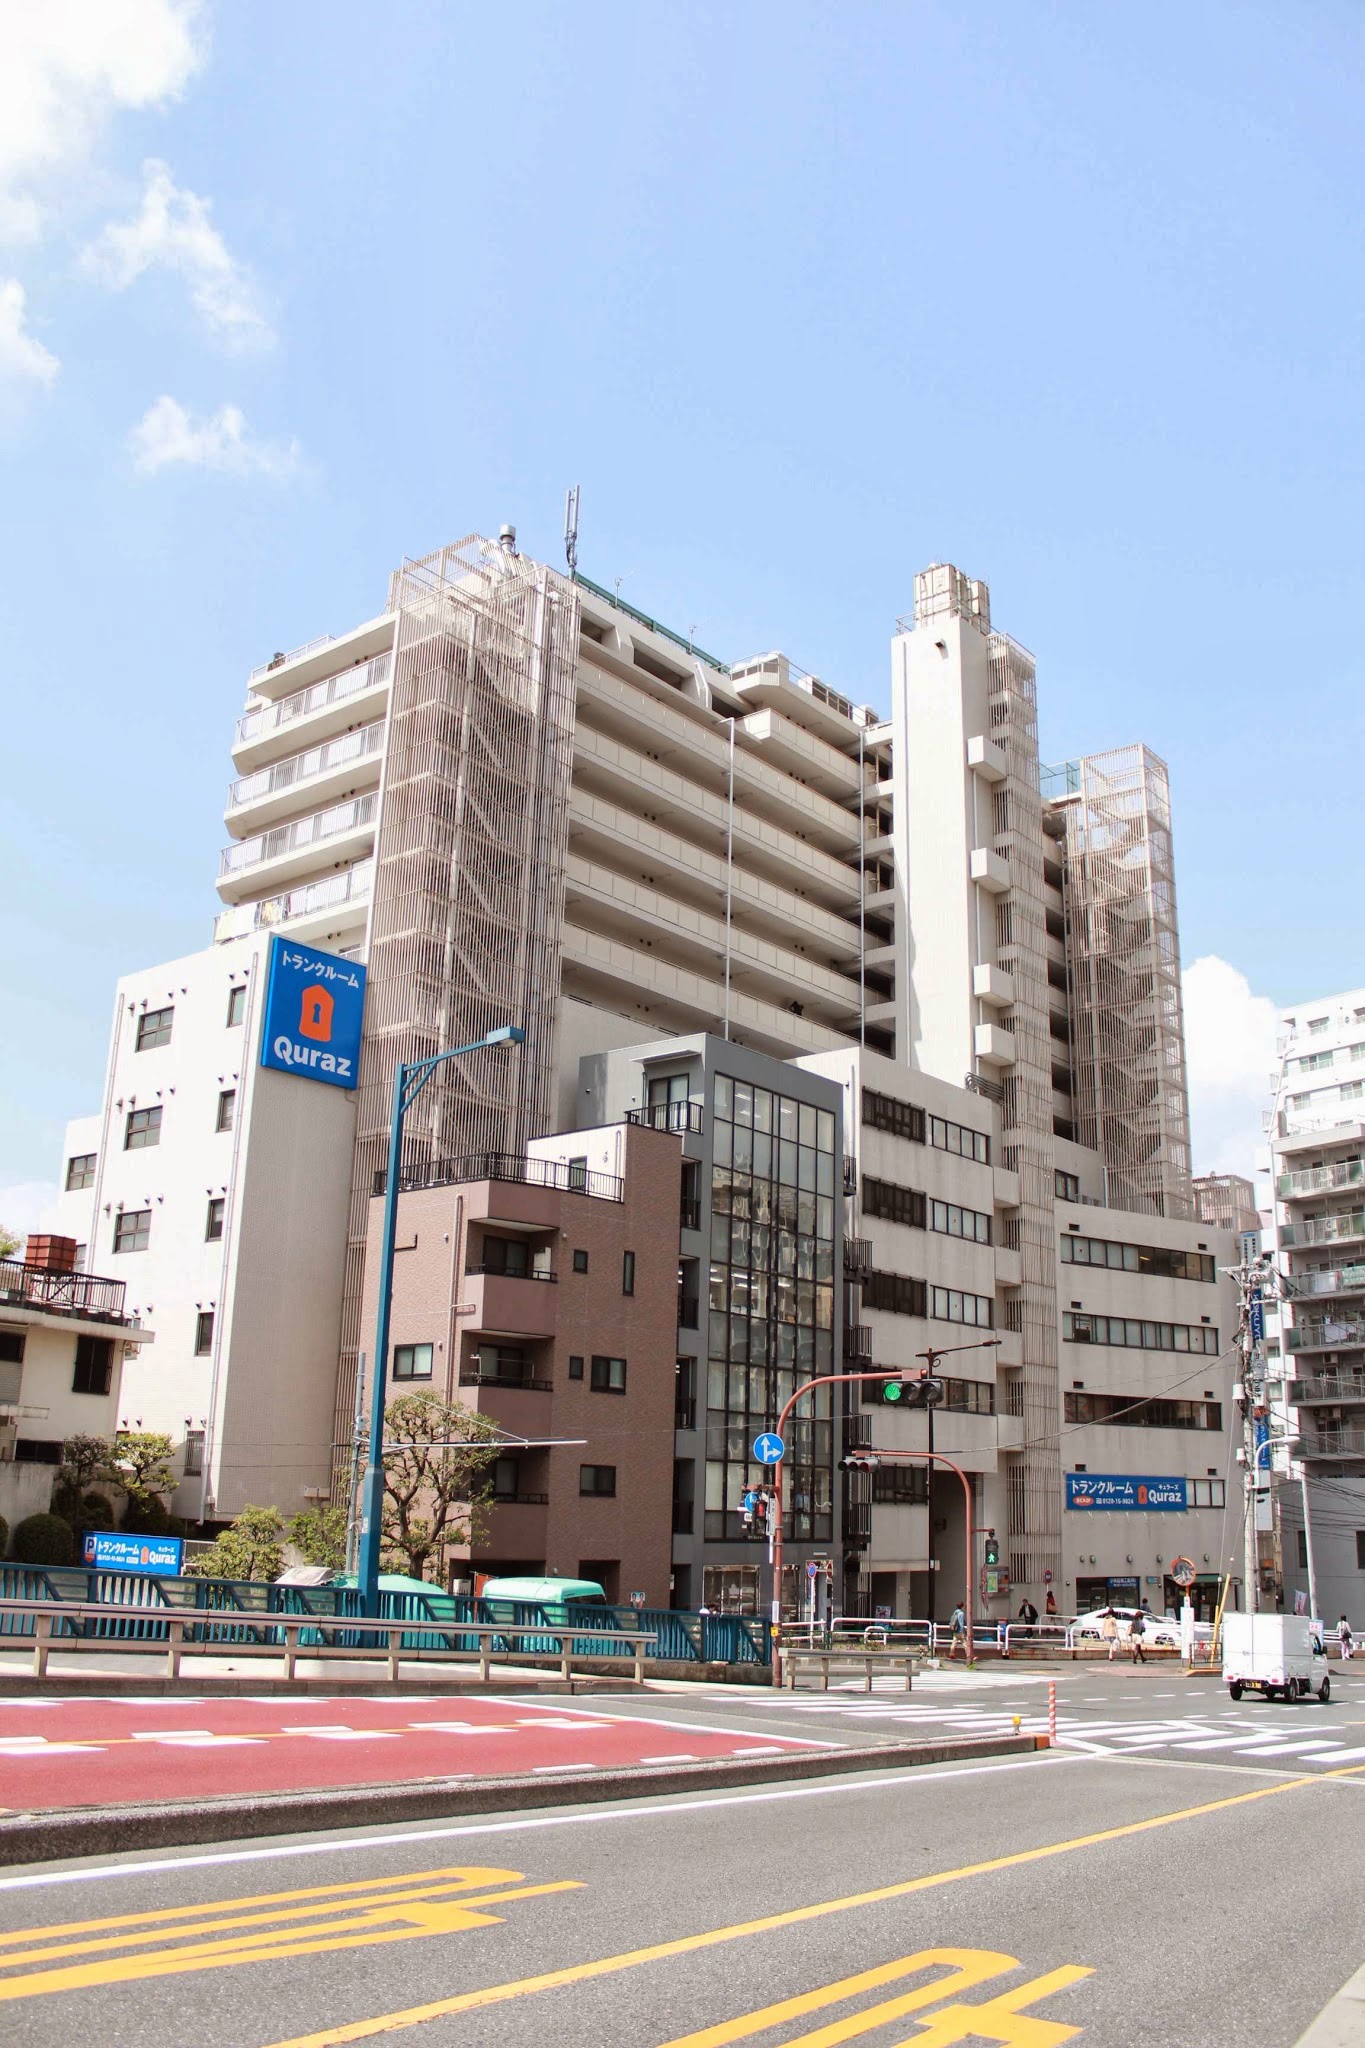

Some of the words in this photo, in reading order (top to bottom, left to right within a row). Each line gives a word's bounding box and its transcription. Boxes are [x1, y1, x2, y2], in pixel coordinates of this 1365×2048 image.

[282, 950, 359, 988] トランクルーム
[274, 1036, 351, 1077] Quraz
[1072, 1480, 1133, 1494] トランクルーム
[1148, 1490, 1182, 1504] Quraz
[87, 1538, 95, 1552] P
[98, 1541, 140, 1555] トランクルーム
[149, 1551, 177, 1564] Quraz
